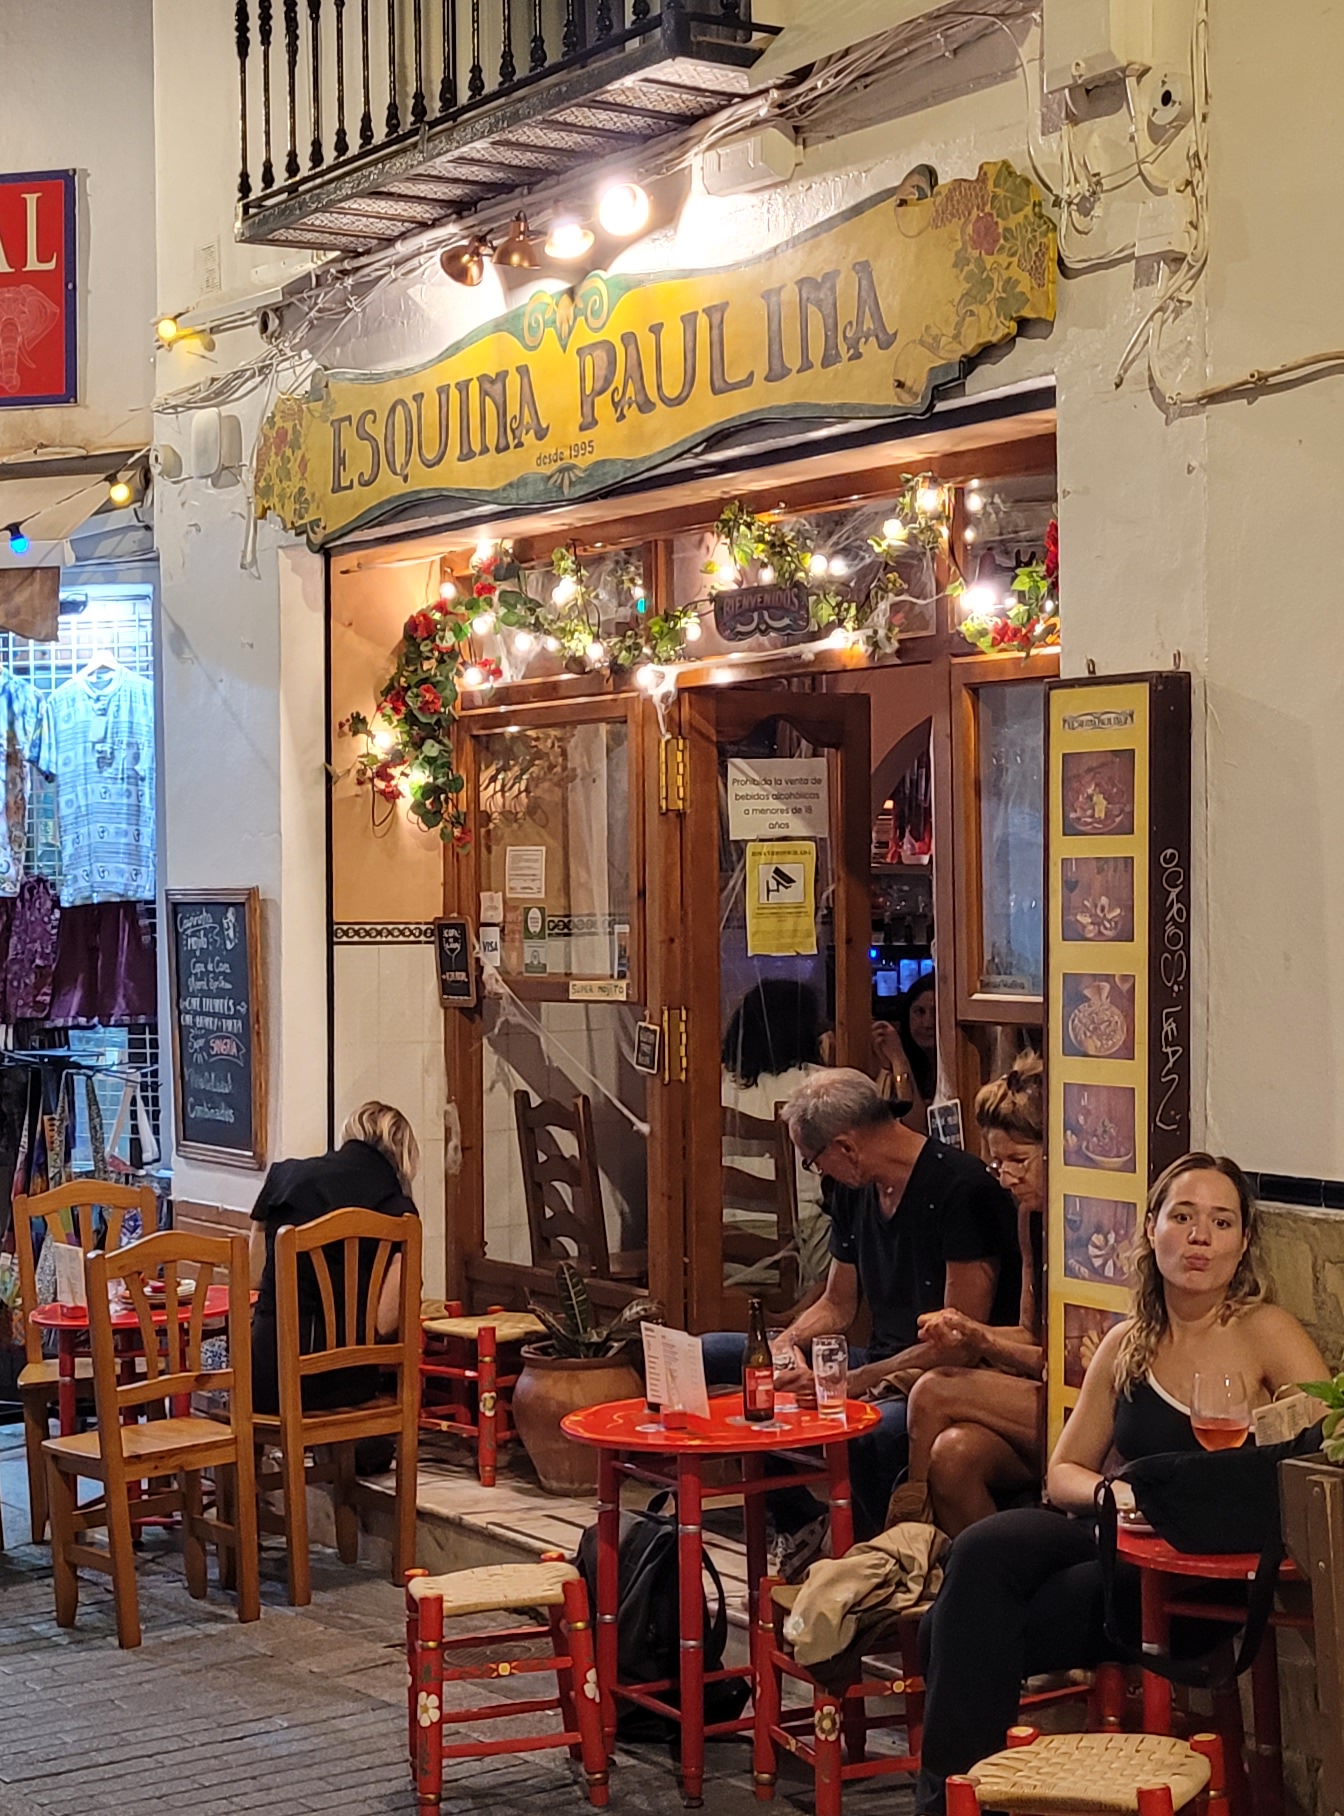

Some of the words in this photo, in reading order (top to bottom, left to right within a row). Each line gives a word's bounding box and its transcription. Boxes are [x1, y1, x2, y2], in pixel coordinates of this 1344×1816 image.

[329, 364, 549, 494] ESQUINA
[577, 259, 898, 432] PAULINA
[536, 447, 564, 467] desde
[569, 440, 595, 459] 1995
[723, 587, 800, 617] BIENVENIDOS
[774, 777, 783, 786] la
[785, 777, 809, 786] venta
[811, 777, 822, 786] de
[735, 792, 770, 801] bebidas
[743, 808, 750, 816] a
[752, 807, 790, 816] menores
[791, 806, 803, 815] de
[768, 820, 790, 830] años
[482, 940, 498, 952] VISA
